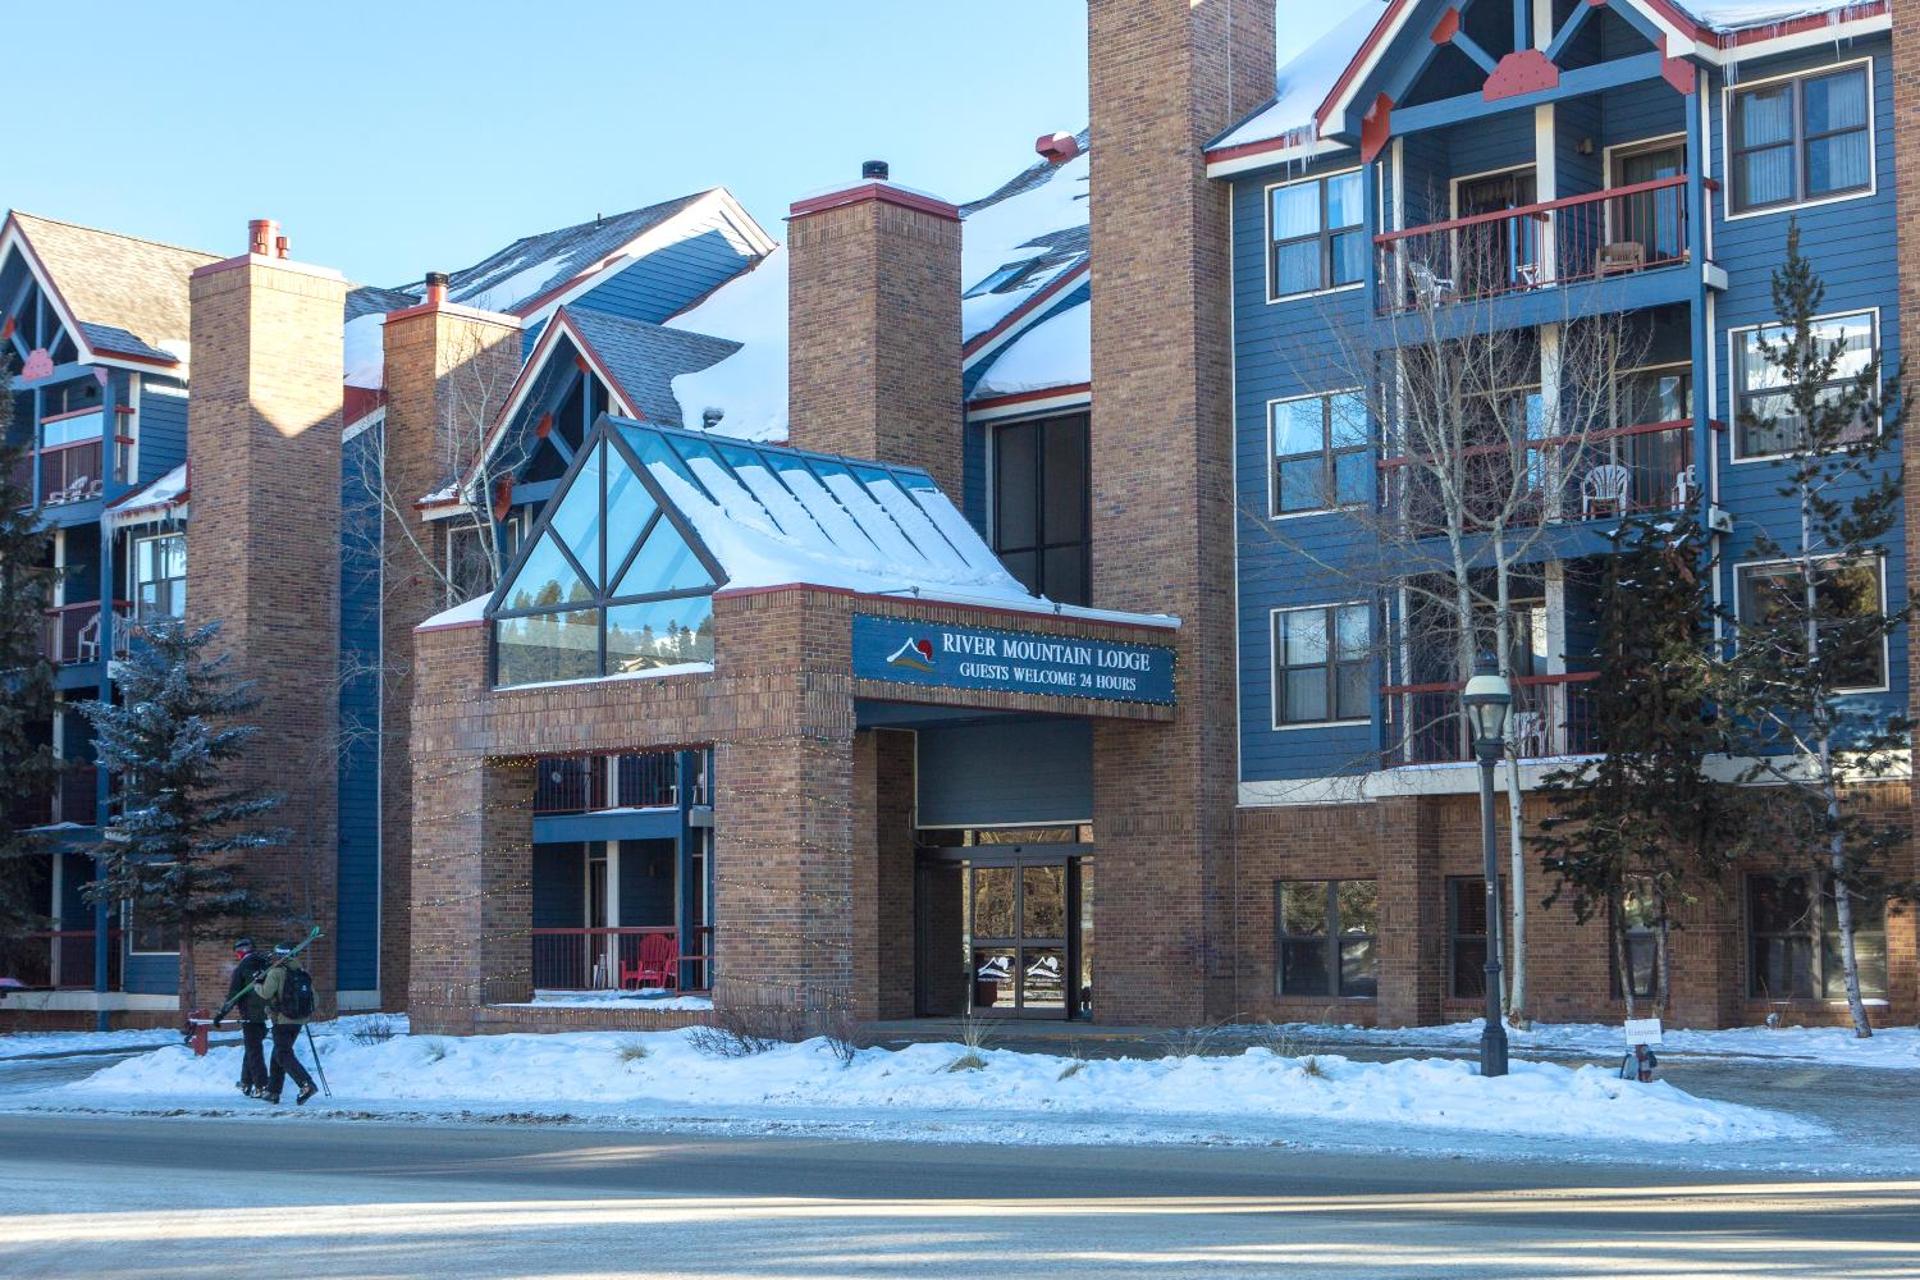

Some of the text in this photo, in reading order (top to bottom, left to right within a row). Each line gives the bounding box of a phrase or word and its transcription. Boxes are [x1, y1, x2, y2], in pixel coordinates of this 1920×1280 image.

[943, 633, 1150, 672] RIVER MOUNTAIN LODGE
[960, 662, 1136, 691] GUESTS WELCOME 24 HOURS
